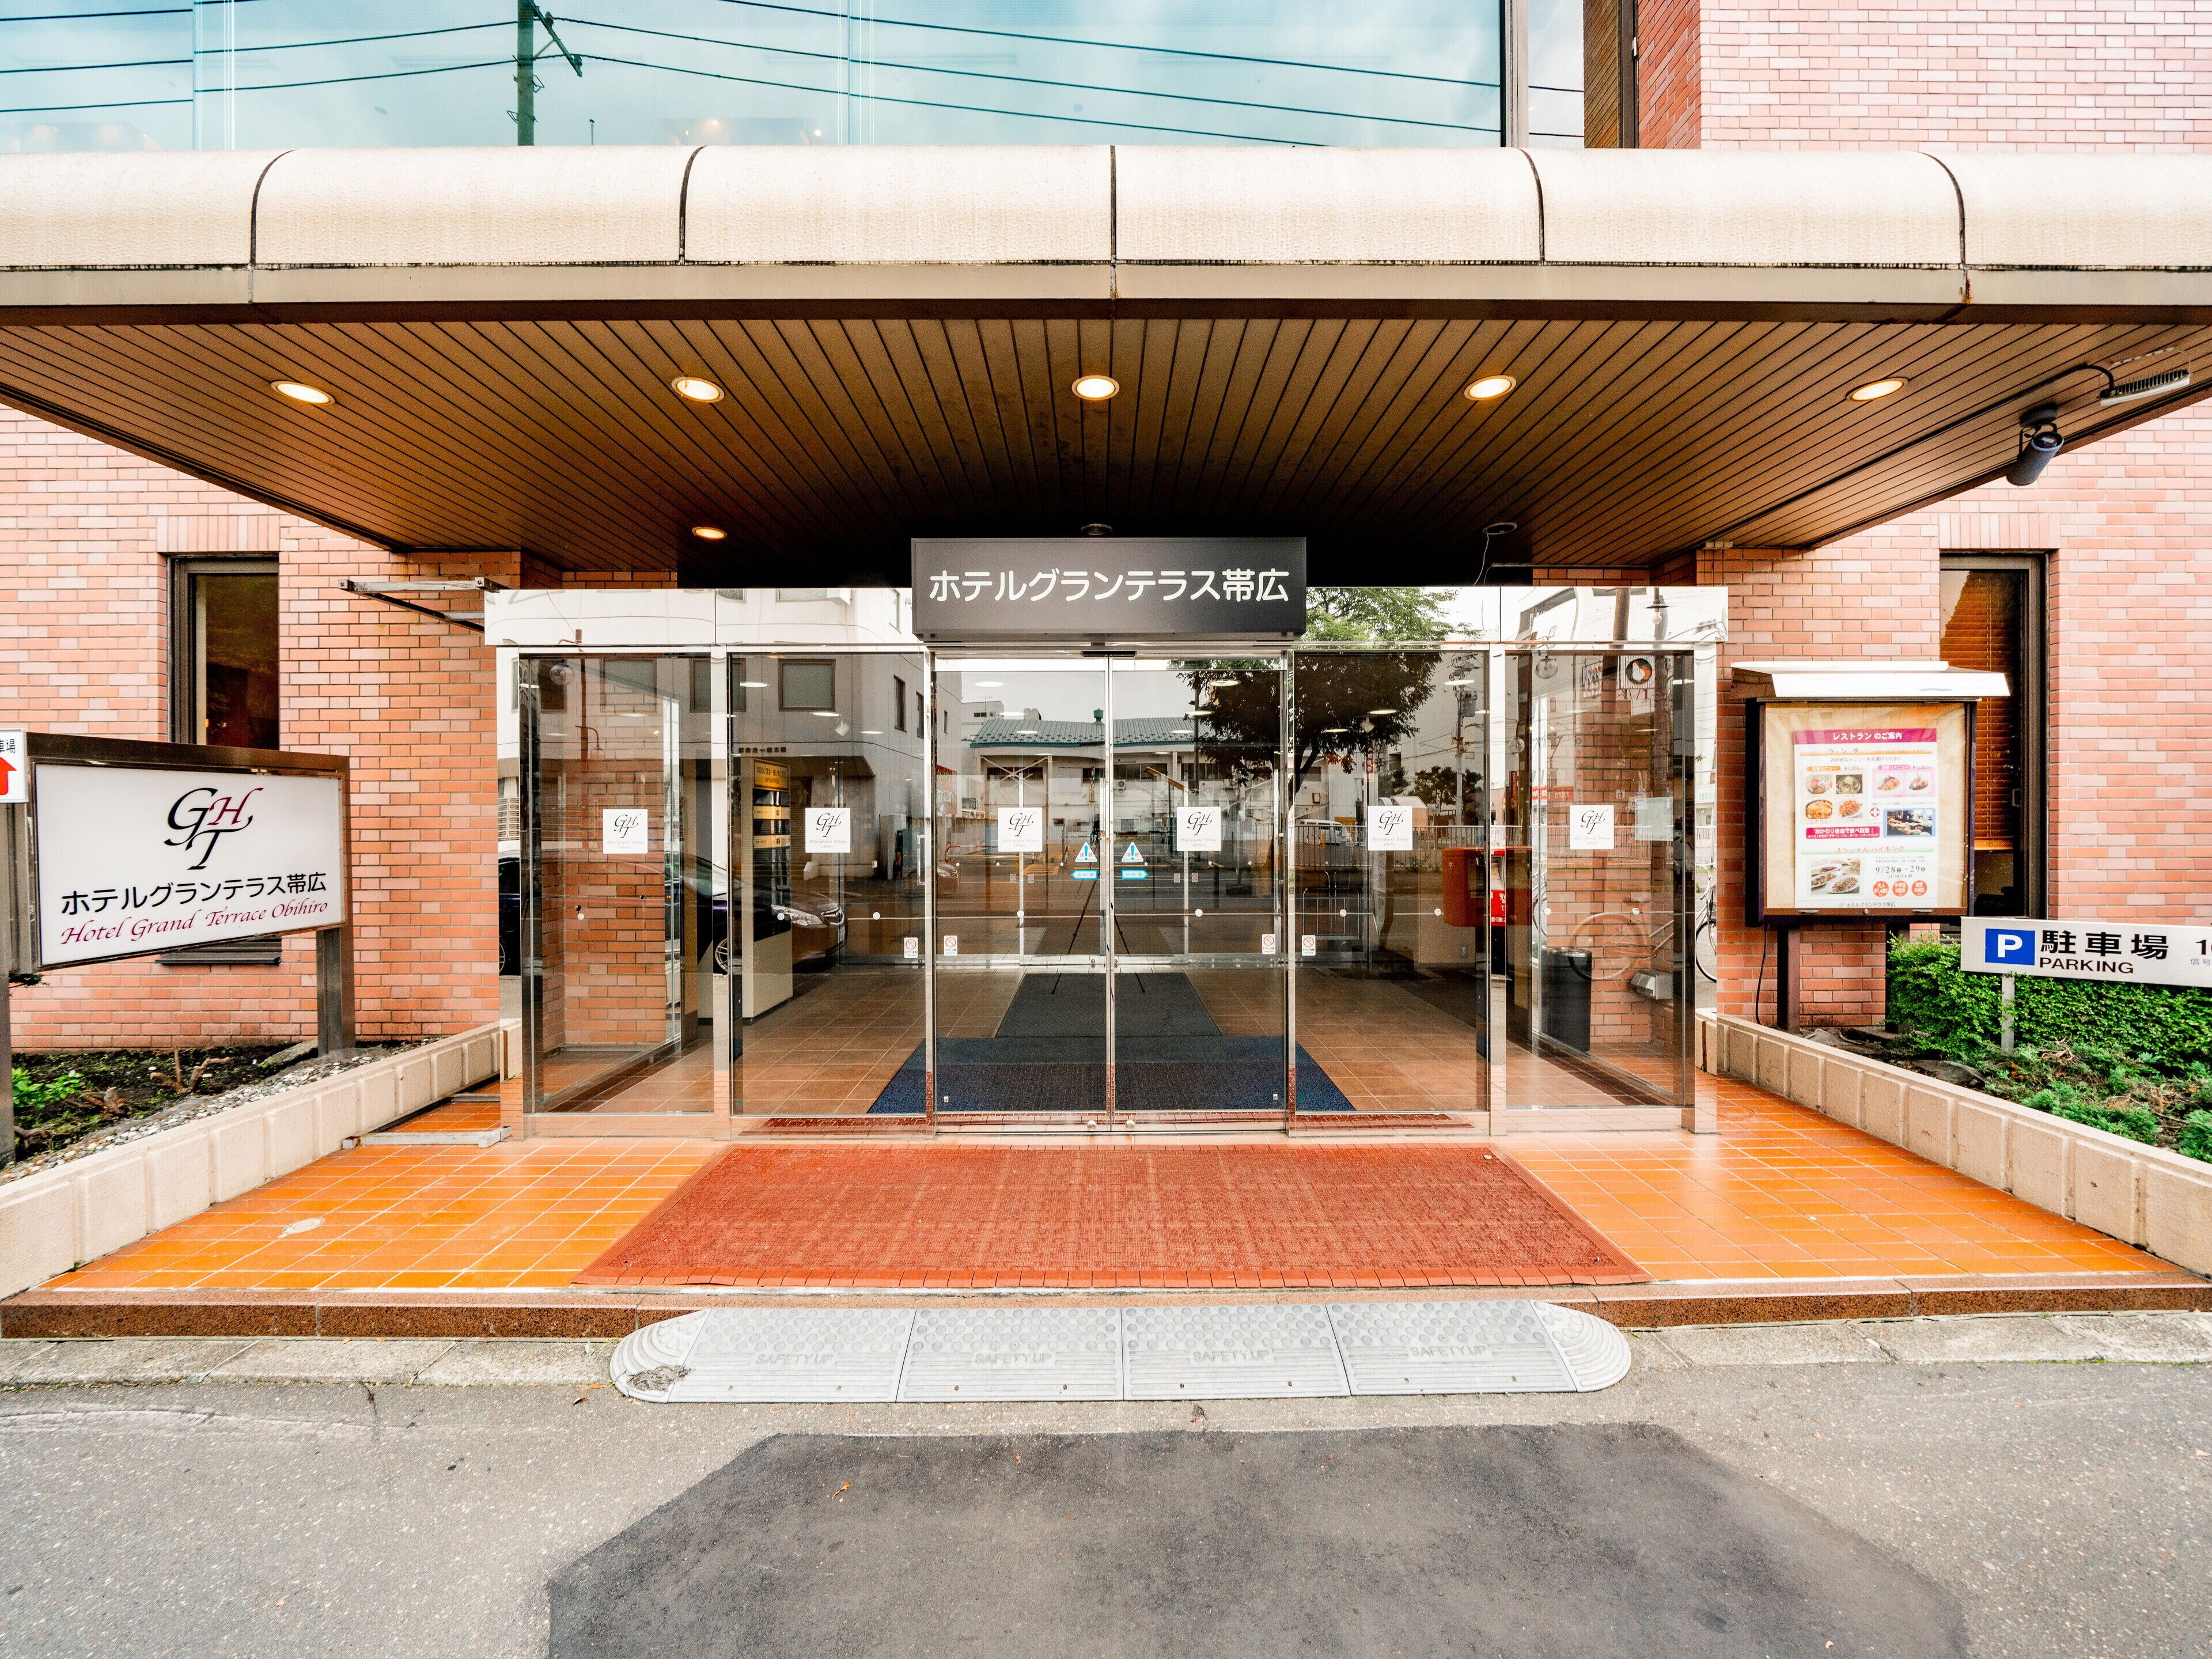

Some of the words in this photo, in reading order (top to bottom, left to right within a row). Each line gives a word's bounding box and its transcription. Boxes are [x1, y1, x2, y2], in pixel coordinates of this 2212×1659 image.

[929, 568, 1289, 602] ホテルグランテラス帯広
[1833, 732, 1872, 741] レストラン
[61, 872, 327, 915] ホテルグランテラス帯広
[60, 916, 132, 944] Hotel
[130, 909, 202, 941] Grand
[204, 906, 267, 927] Terrace
[272, 897, 328, 919] Obihiro
[1998, 934, 2022, 958] P
[2040, 930, 2169, 960] 駐車場
[2039, 957, 2134, 974] PARKING
